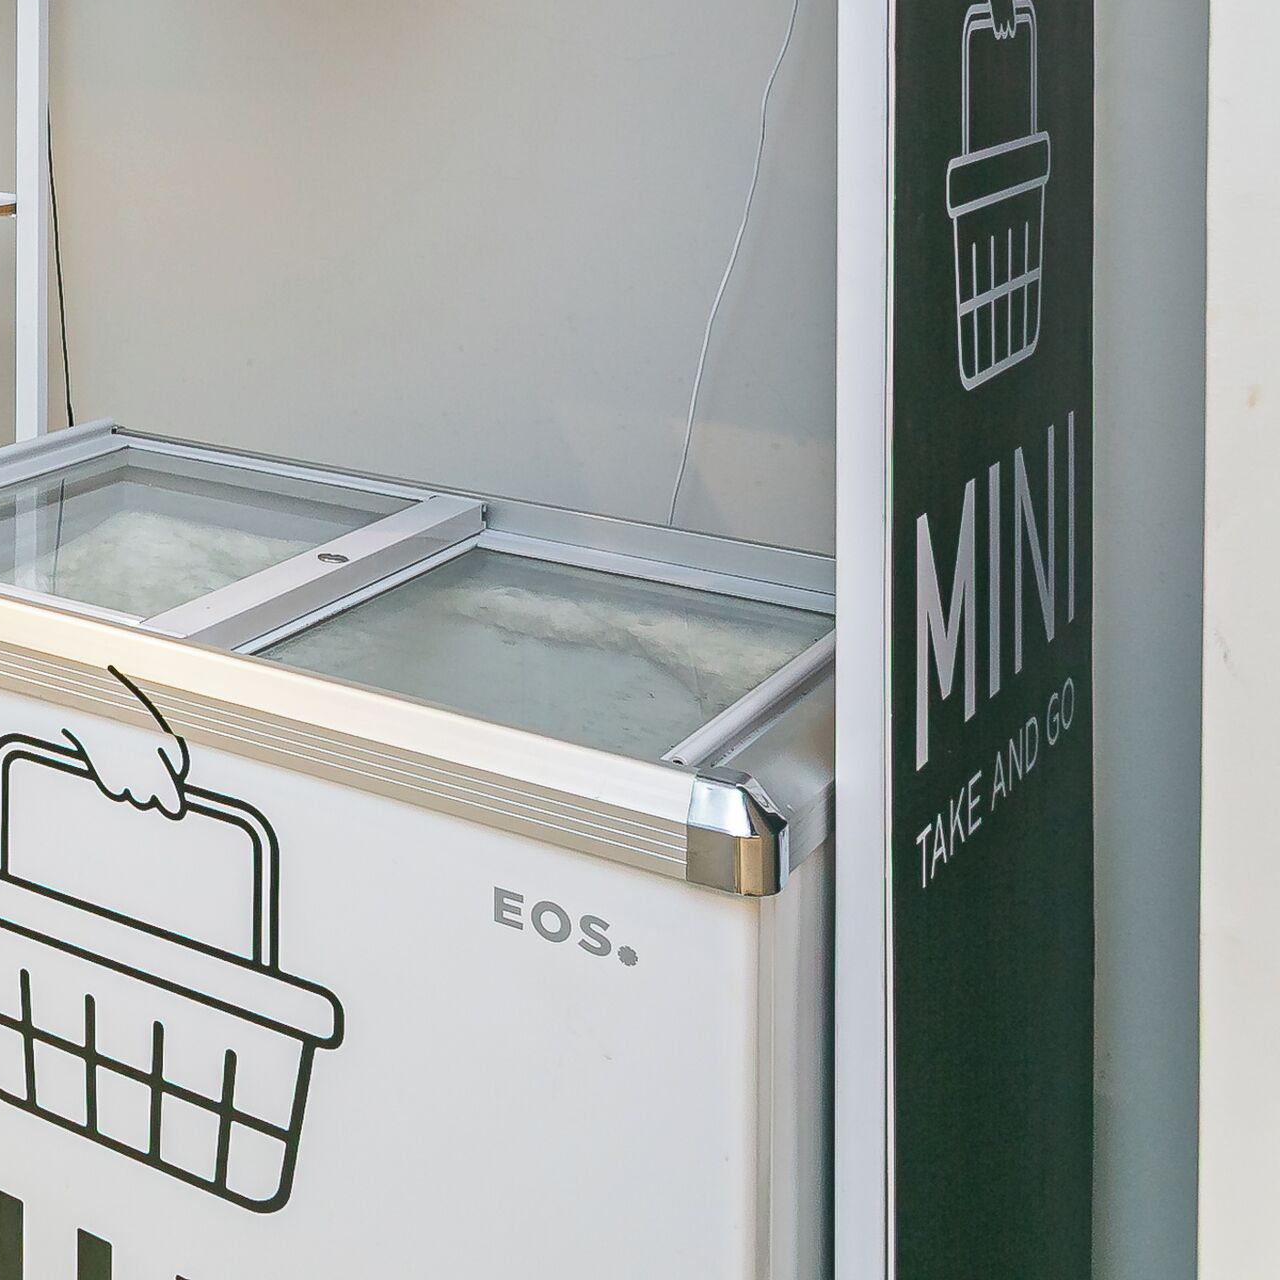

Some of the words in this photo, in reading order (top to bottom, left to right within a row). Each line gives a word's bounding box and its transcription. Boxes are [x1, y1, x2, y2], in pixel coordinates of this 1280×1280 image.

[916, 410, 1075, 771] MINI
[916, 770, 982, 889] TAKE
[991, 716, 1039, 811] AND
[1047, 677, 1075, 746] GO
